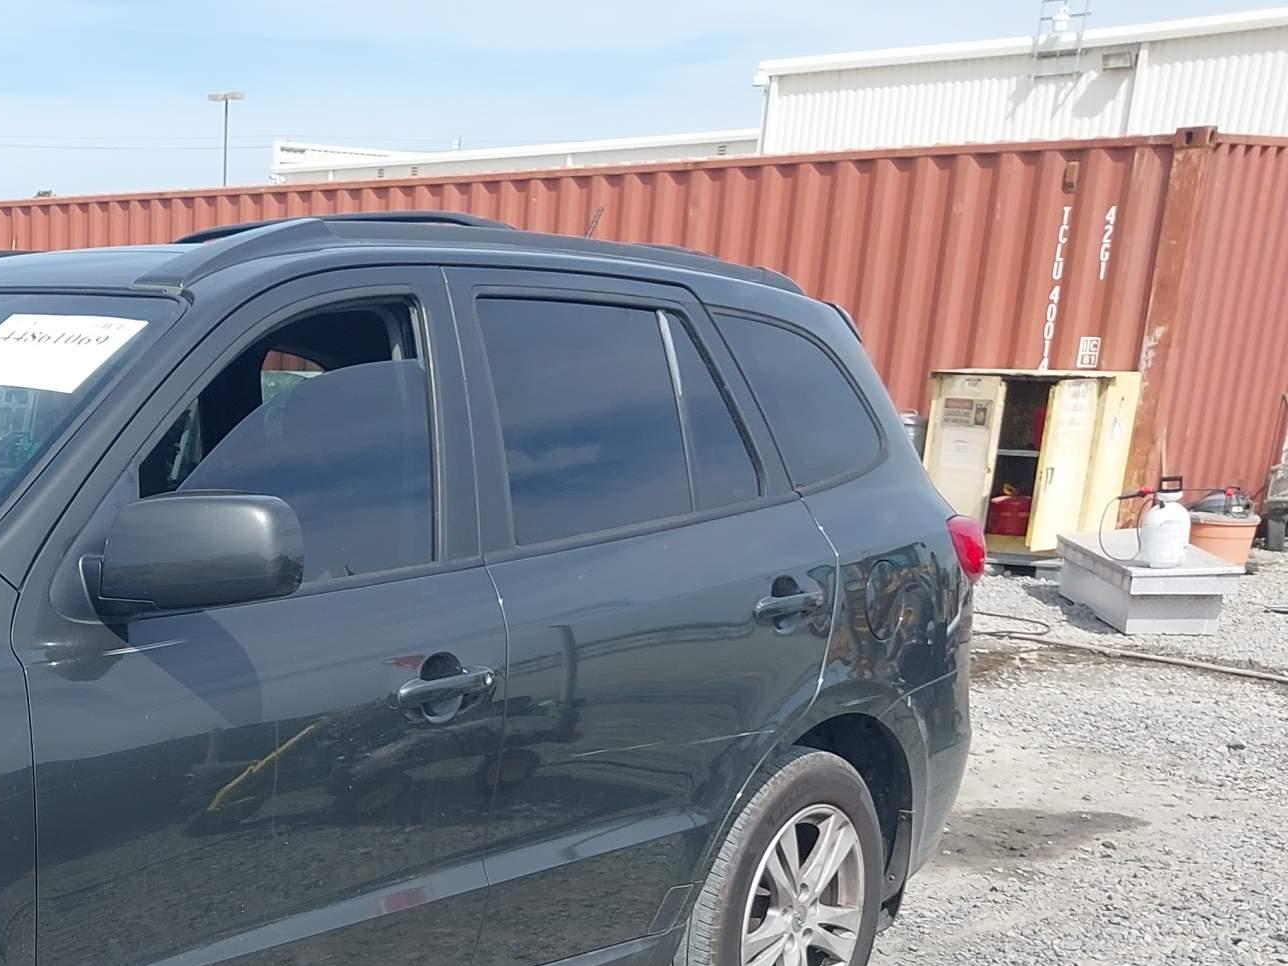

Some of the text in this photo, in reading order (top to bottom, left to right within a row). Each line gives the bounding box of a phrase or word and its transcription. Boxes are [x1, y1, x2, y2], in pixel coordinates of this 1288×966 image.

[1052, 206, 1072, 280] TCLU
[1099, 205, 1118, 281] 42G1
[0, 331, 110, 345] 44861069
